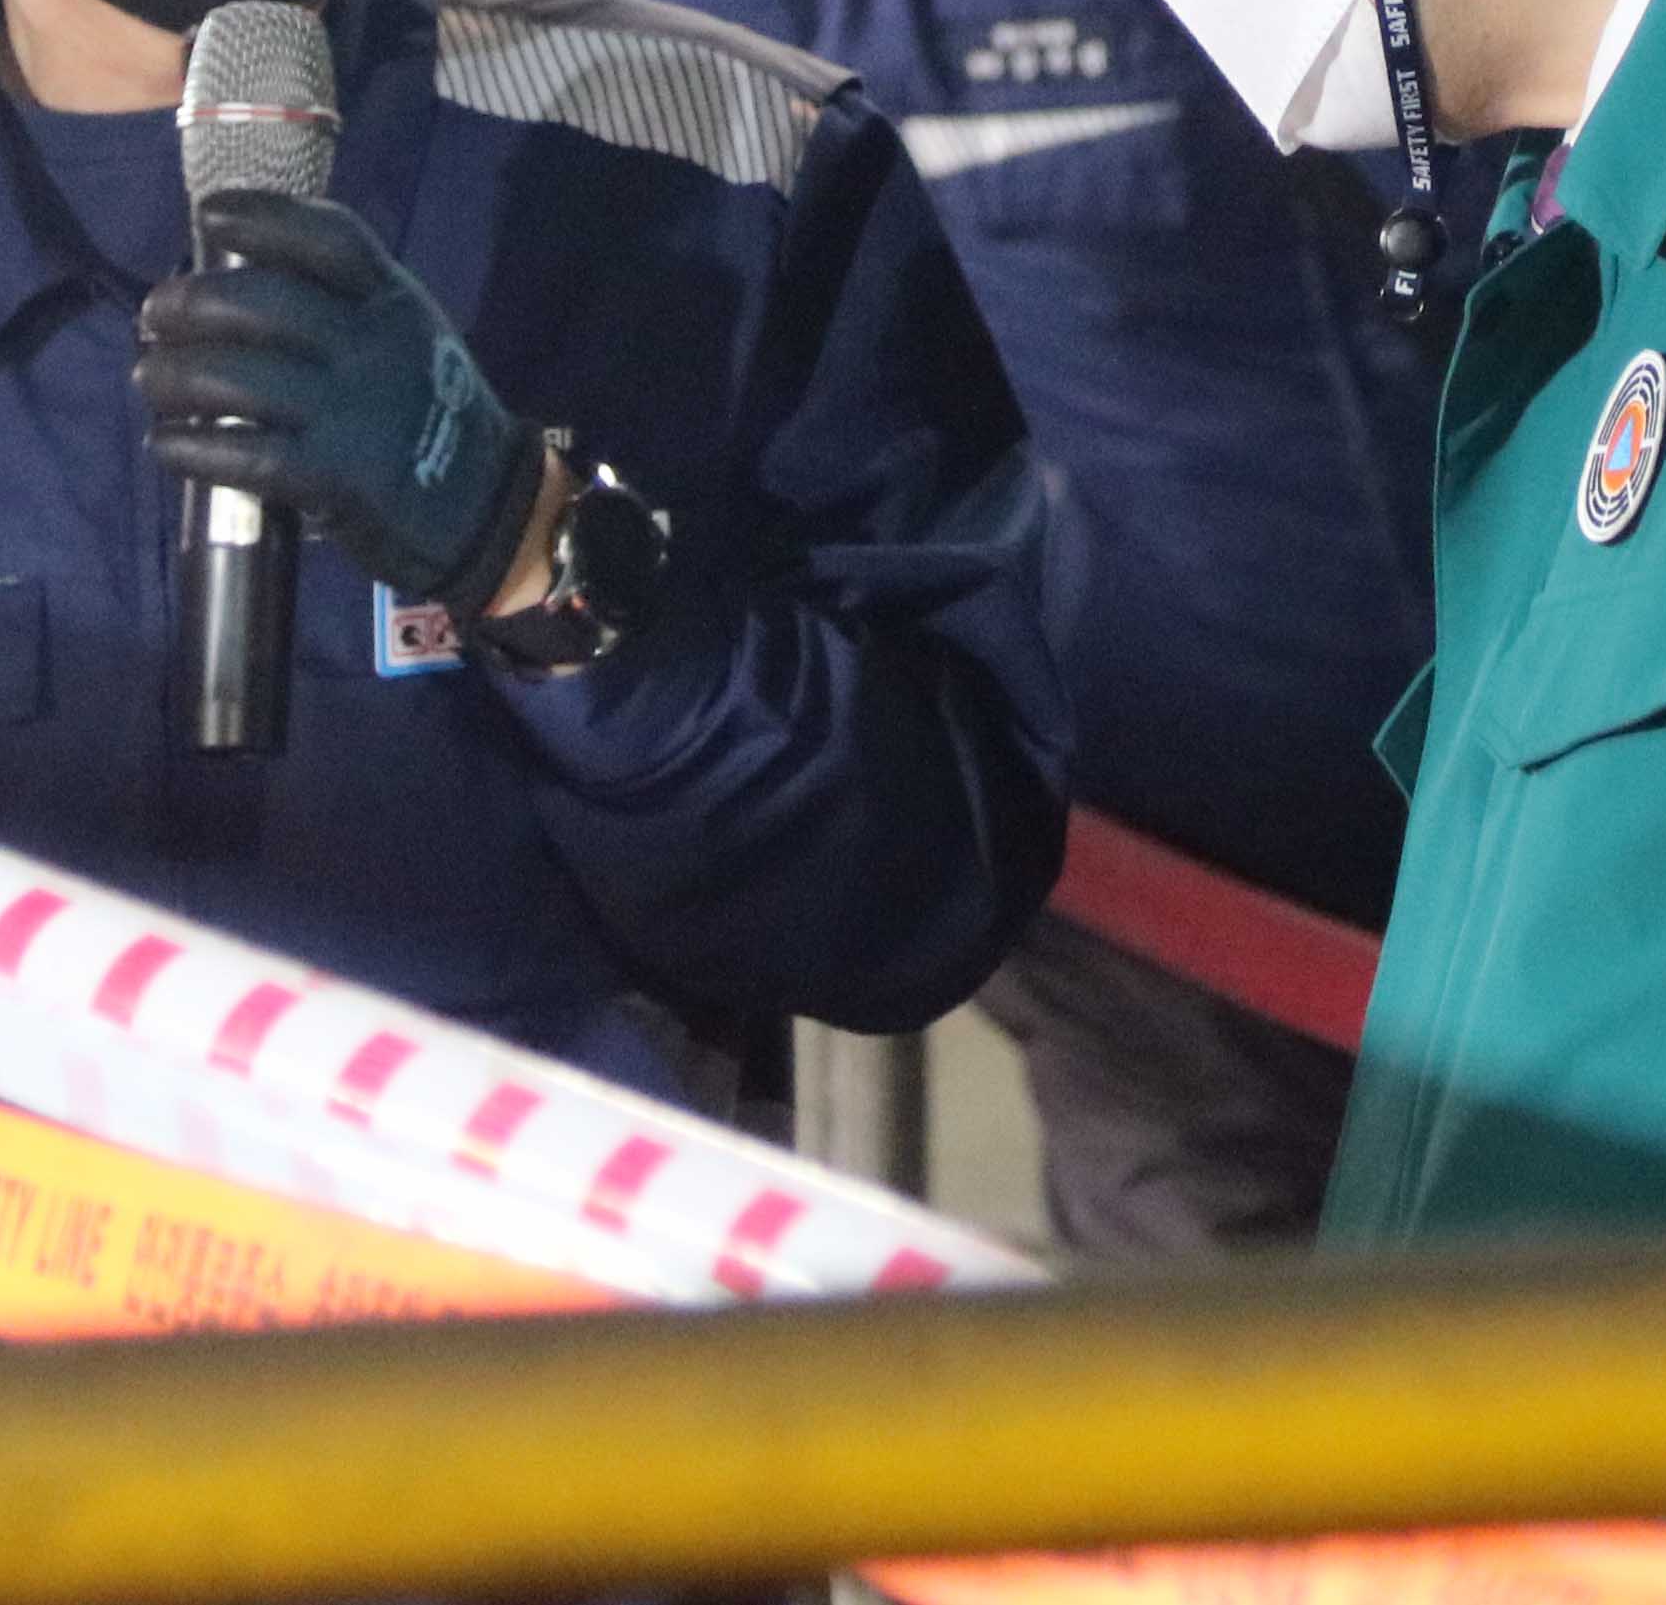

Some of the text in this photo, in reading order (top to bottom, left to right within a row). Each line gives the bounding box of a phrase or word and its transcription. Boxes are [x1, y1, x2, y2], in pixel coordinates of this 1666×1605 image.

[1396, 68, 1432, 192] SAFETY FIRST
[33, 1192, 114, 1288] LINE
